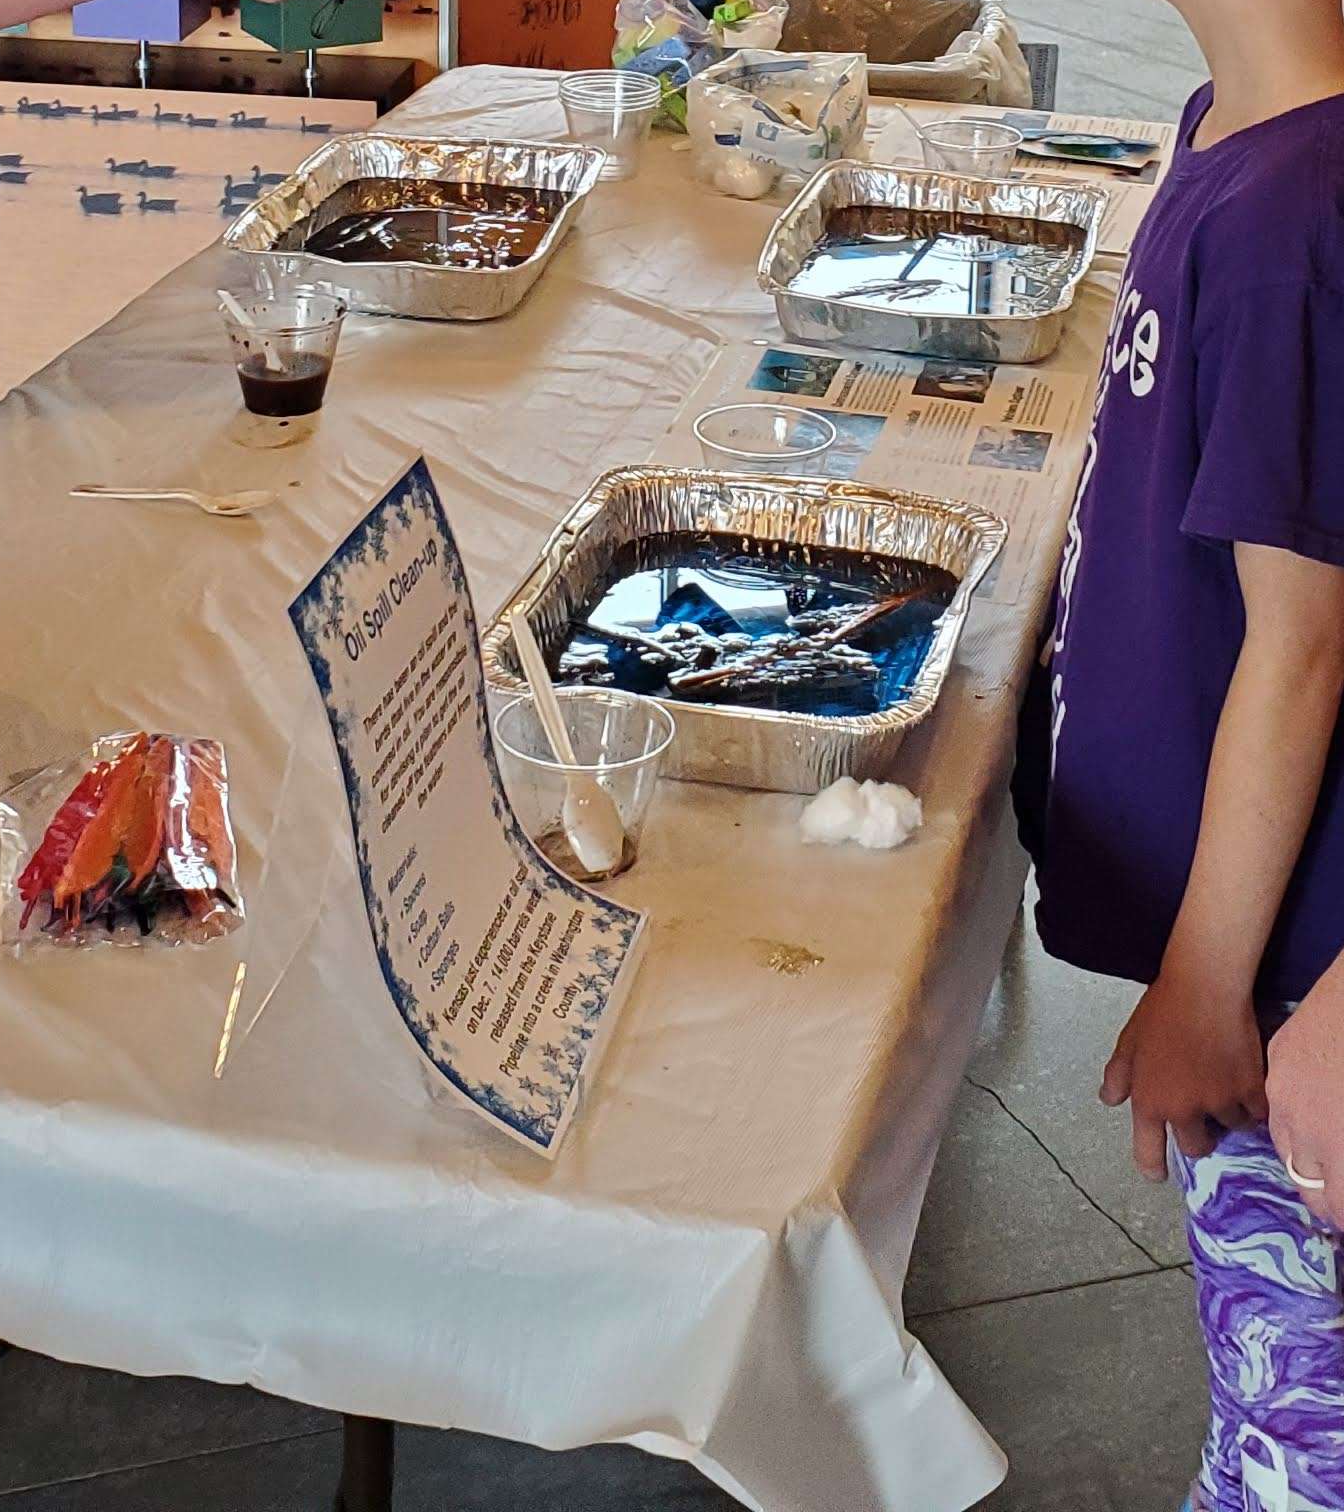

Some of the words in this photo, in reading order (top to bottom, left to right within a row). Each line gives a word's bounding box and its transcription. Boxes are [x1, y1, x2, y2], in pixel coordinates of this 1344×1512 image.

[346, 622, 367, 661] Oil
[363, 589, 392, 639] Spill
[389, 538, 437, 605] Clean-up
[363, 704, 383, 734] There
[383, 688, 394, 710] has
[394, 666, 409, 693] been
[410, 655, 417, 673] an
[417, 641, 425, 661] oil
[426, 624, 437, 651] spill
[438, 609, 449, 635] and
[448, 600, 458, 620] the
[375, 723, 391, 752] birds
[391, 704, 404, 729] that
[403, 690, 414, 710] live
[415, 681, 421, 696] in
[421, 667, 431, 686] the
[432, 643, 446, 672] water
[447, 631, 457, 651] are
[372, 745, 396, 788] covered
[396, 735, 402, 752] in
[413, 704, 425, 723] You
[425, 689, 436, 709] are
[436, 644, 467, 692] responsible
[380, 783, 390, 805] for
[391, 748, 415, 790] devising
[415, 741, 420, 753] a
[420, 722, 432, 750] plan
[432, 713, 439, 728] to
[439, 696, 449, 721] get
[448, 685, 457, 704] the
[457, 670, 466, 690] oil
[382, 788, 406, 834] cleaned
[406, 774, 414, 797] off
[414, 763, 424, 784] the
[424, 729, 447, 768] feathers
[447, 710, 458, 734] and
[457, 694, 471, 719] from
[418, 788, 427, 810] the
[403, 872, 426, 914] Spoons
[410, 908, 428, 939] Soap
[420, 925, 442, 963] Cotton
[438, 899, 455, 930] Balls
[442, 983, 470, 1026] Kansas
[464, 960, 479, 992] just
[474, 904, 508, 967] experienced
[503, 894, 512, 911] an
[509, 878, 520, 897] oil
[515, 860, 529, 886] spill
[527, 911, 557, 959] Keystone
[552, 909, 585, 965] Washington
[431, 940, 459, 986] Sponges
[466, 1017, 479, 1035] on
[491, 943, 514, 980] 14,000
[510, 912, 531, 950] barrels
[525, 888, 542, 915] were
[508, 971, 529, 999] from
[519, 955, 537, 975] the
[548, 963, 561, 976] in
[531, 1003, 542, 1014] a
[535, 975, 555, 1005] creek
[552, 981, 582, 1019] County
[490, 993, 518, 1044] released
[518, 1011, 537, 1035] into
[499, 1033, 529, 1077] Pipeline
